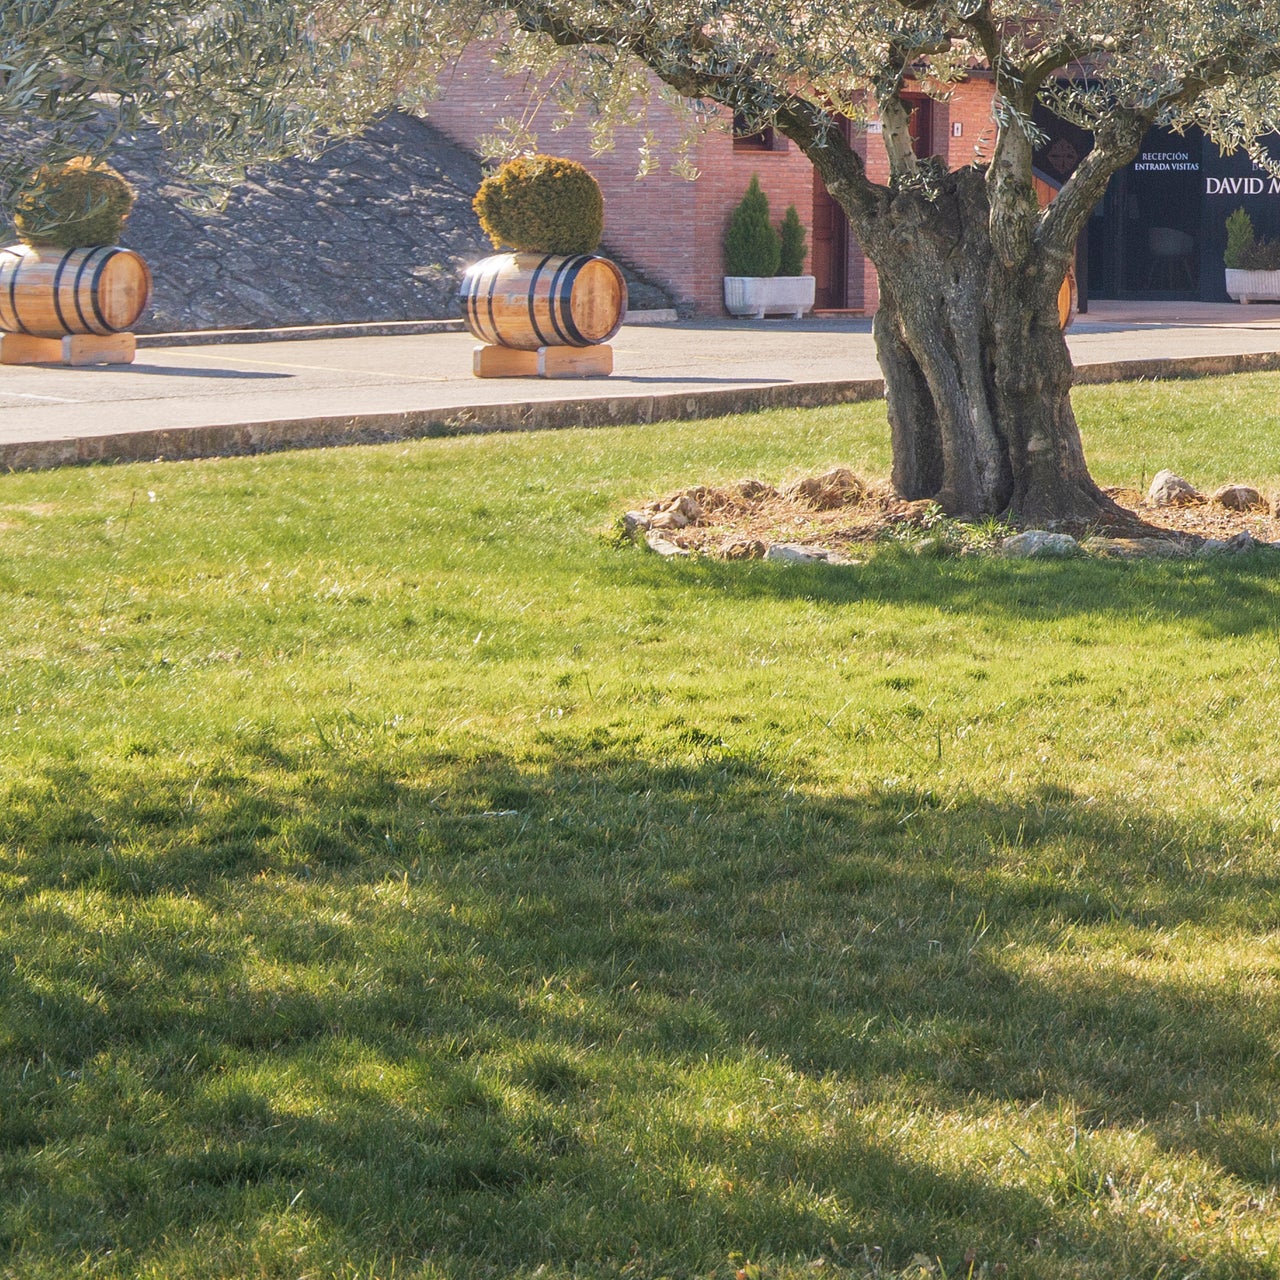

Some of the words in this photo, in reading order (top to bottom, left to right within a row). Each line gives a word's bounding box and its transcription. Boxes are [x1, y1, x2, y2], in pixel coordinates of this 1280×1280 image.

[1142, 152, 1189, 161] RECEPCIÓN
[1135, 163, 1171, 171] ENTRADA
[1171, 163, 1199, 171] VISITAS
[1206, 177, 1263, 194] DAVID
